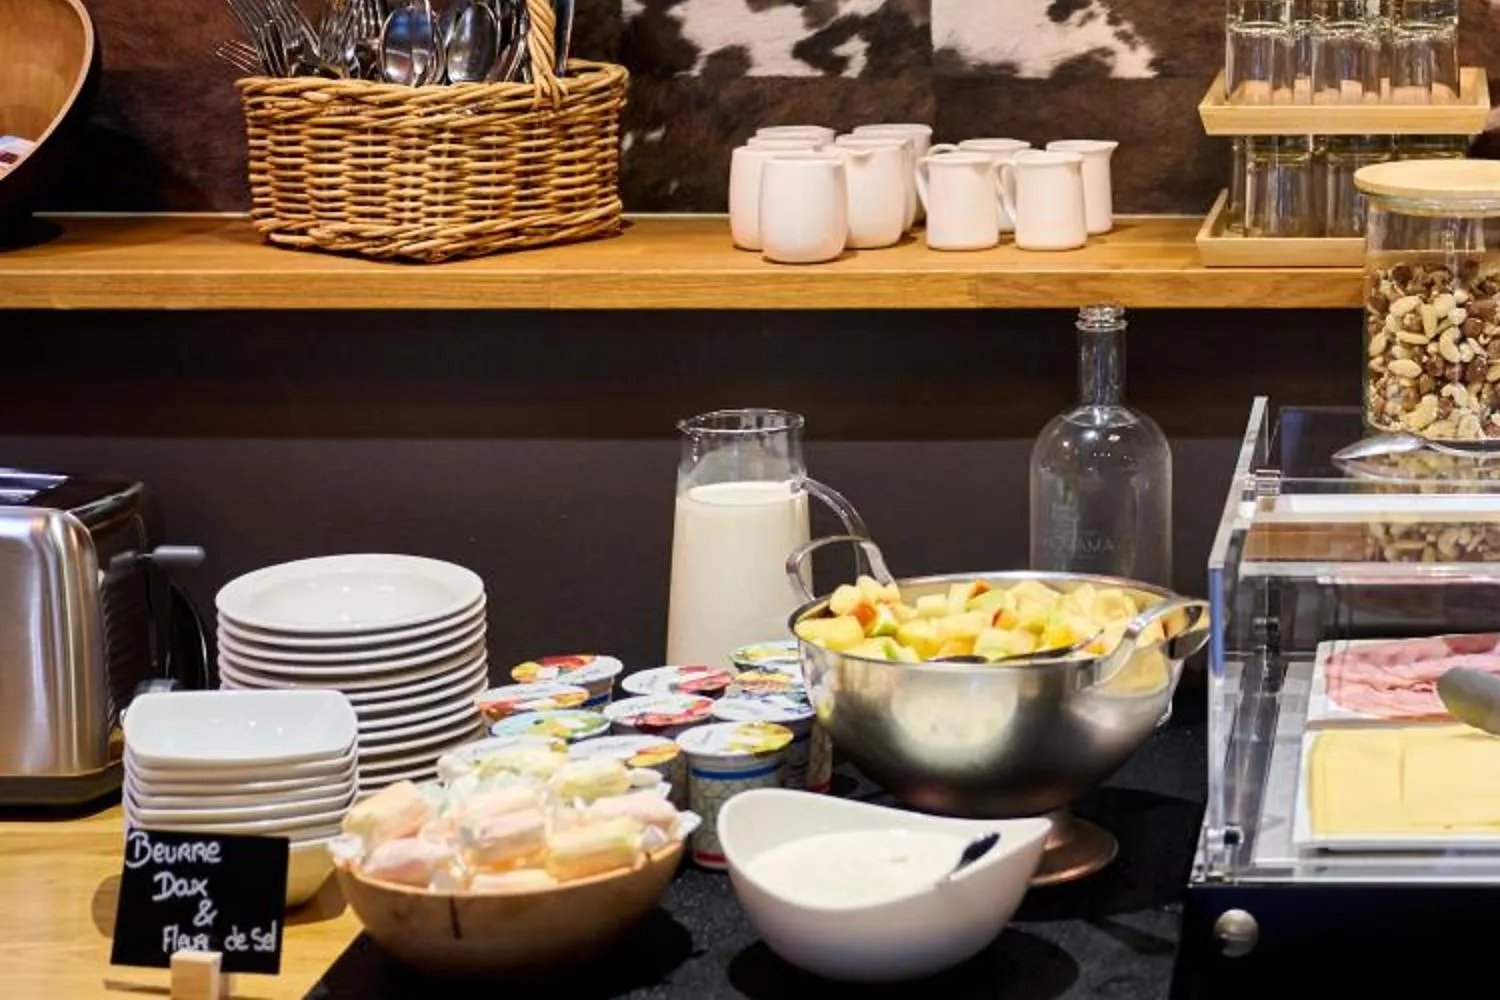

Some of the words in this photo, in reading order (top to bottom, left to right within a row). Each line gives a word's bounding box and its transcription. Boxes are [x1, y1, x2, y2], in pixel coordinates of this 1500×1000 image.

[193, 899, 218, 927] &
[224, 925, 249, 952] de
[251, 920, 277, 953] Sel
